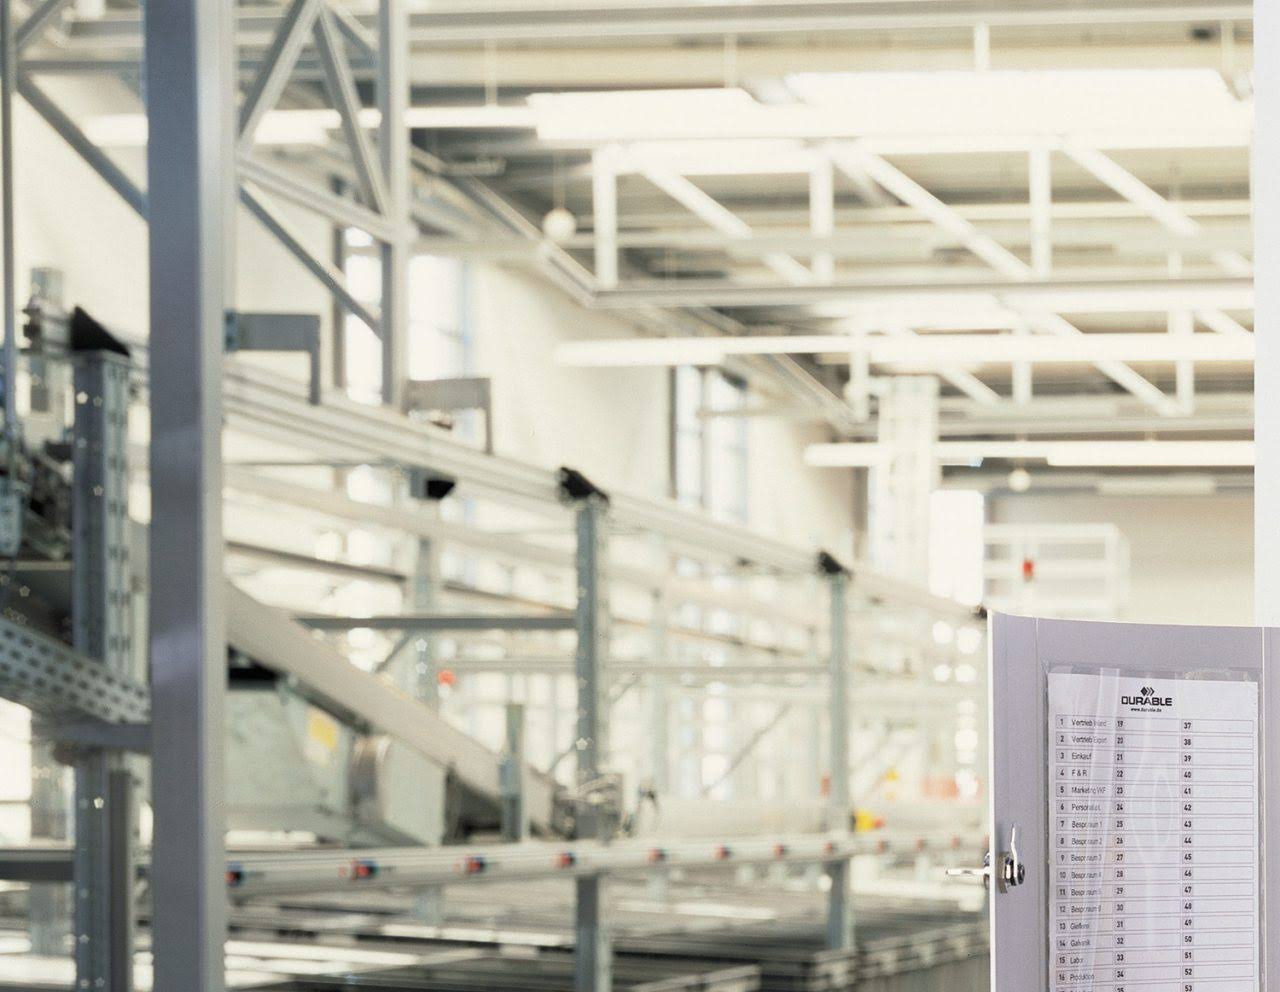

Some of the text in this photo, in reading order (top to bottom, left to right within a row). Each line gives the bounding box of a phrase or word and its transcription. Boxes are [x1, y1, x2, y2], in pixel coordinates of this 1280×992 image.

[1121, 695, 1173, 707] DURABLE
[1060, 718, 1065, 726] 1
[1117, 720, 1124, 728] 19
[1183, 721, 1192, 730] 37
[1060, 735, 1065, 743] 2
[1116, 736, 1124, 745] 20
[1183, 738, 1192, 746] 38
[1060, 752, 1092, 760] 3 Einkauf
[1116, 753, 1123, 761] 21
[1183, 754, 1192, 762] 39
[1116, 769, 1124, 778] 22
[1183, 771, 1192, 779] 40
[1060, 785, 1065, 794] 5
[1116, 786, 1124, 795] 23
[1183, 787, 1192, 795] 41
[1060, 803, 1065, 811] 6
[1116, 803, 1124, 811] 24
[1183, 803, 1192, 812] 42
[1060, 820, 1065, 828] 7
[1116, 820, 1124, 828] 25
[1183, 820, 1192, 828] 43
[1060, 837, 1065, 845] 8
[1116, 837, 1124, 845] 26
[1060, 854, 1065, 862] 9
[1116, 853, 1124, 861] 27
[1183, 853, 1192, 861] 45
[1059, 871, 1067, 879] 10
[1116, 870, 1124, 878] 28
[1184, 869, 1192, 878] 46
[1059, 888, 1066, 896] 11
[1116, 887, 1124, 895] 29
[1184, 885, 1192, 894] 47
[1059, 905, 1066, 913] 12
[1116, 903, 1124, 911] 30
[1184, 902, 1193, 910] 48
[1059, 922, 1066, 930] 13
[1116, 920, 1124, 928] 31
[1116, 937, 1124, 945] 32
[1184, 935, 1193, 943] 50
[1116, 953, 1125, 962] 33
[1184, 951, 1192, 959] 51
[1058, 956, 1066, 964] 15
[1116, 970, 1125, 978] 34
[1184, 967, 1193, 976] 52
[1058, 973, 1066, 981] 16
[1184, 984, 1193, 992] 53
